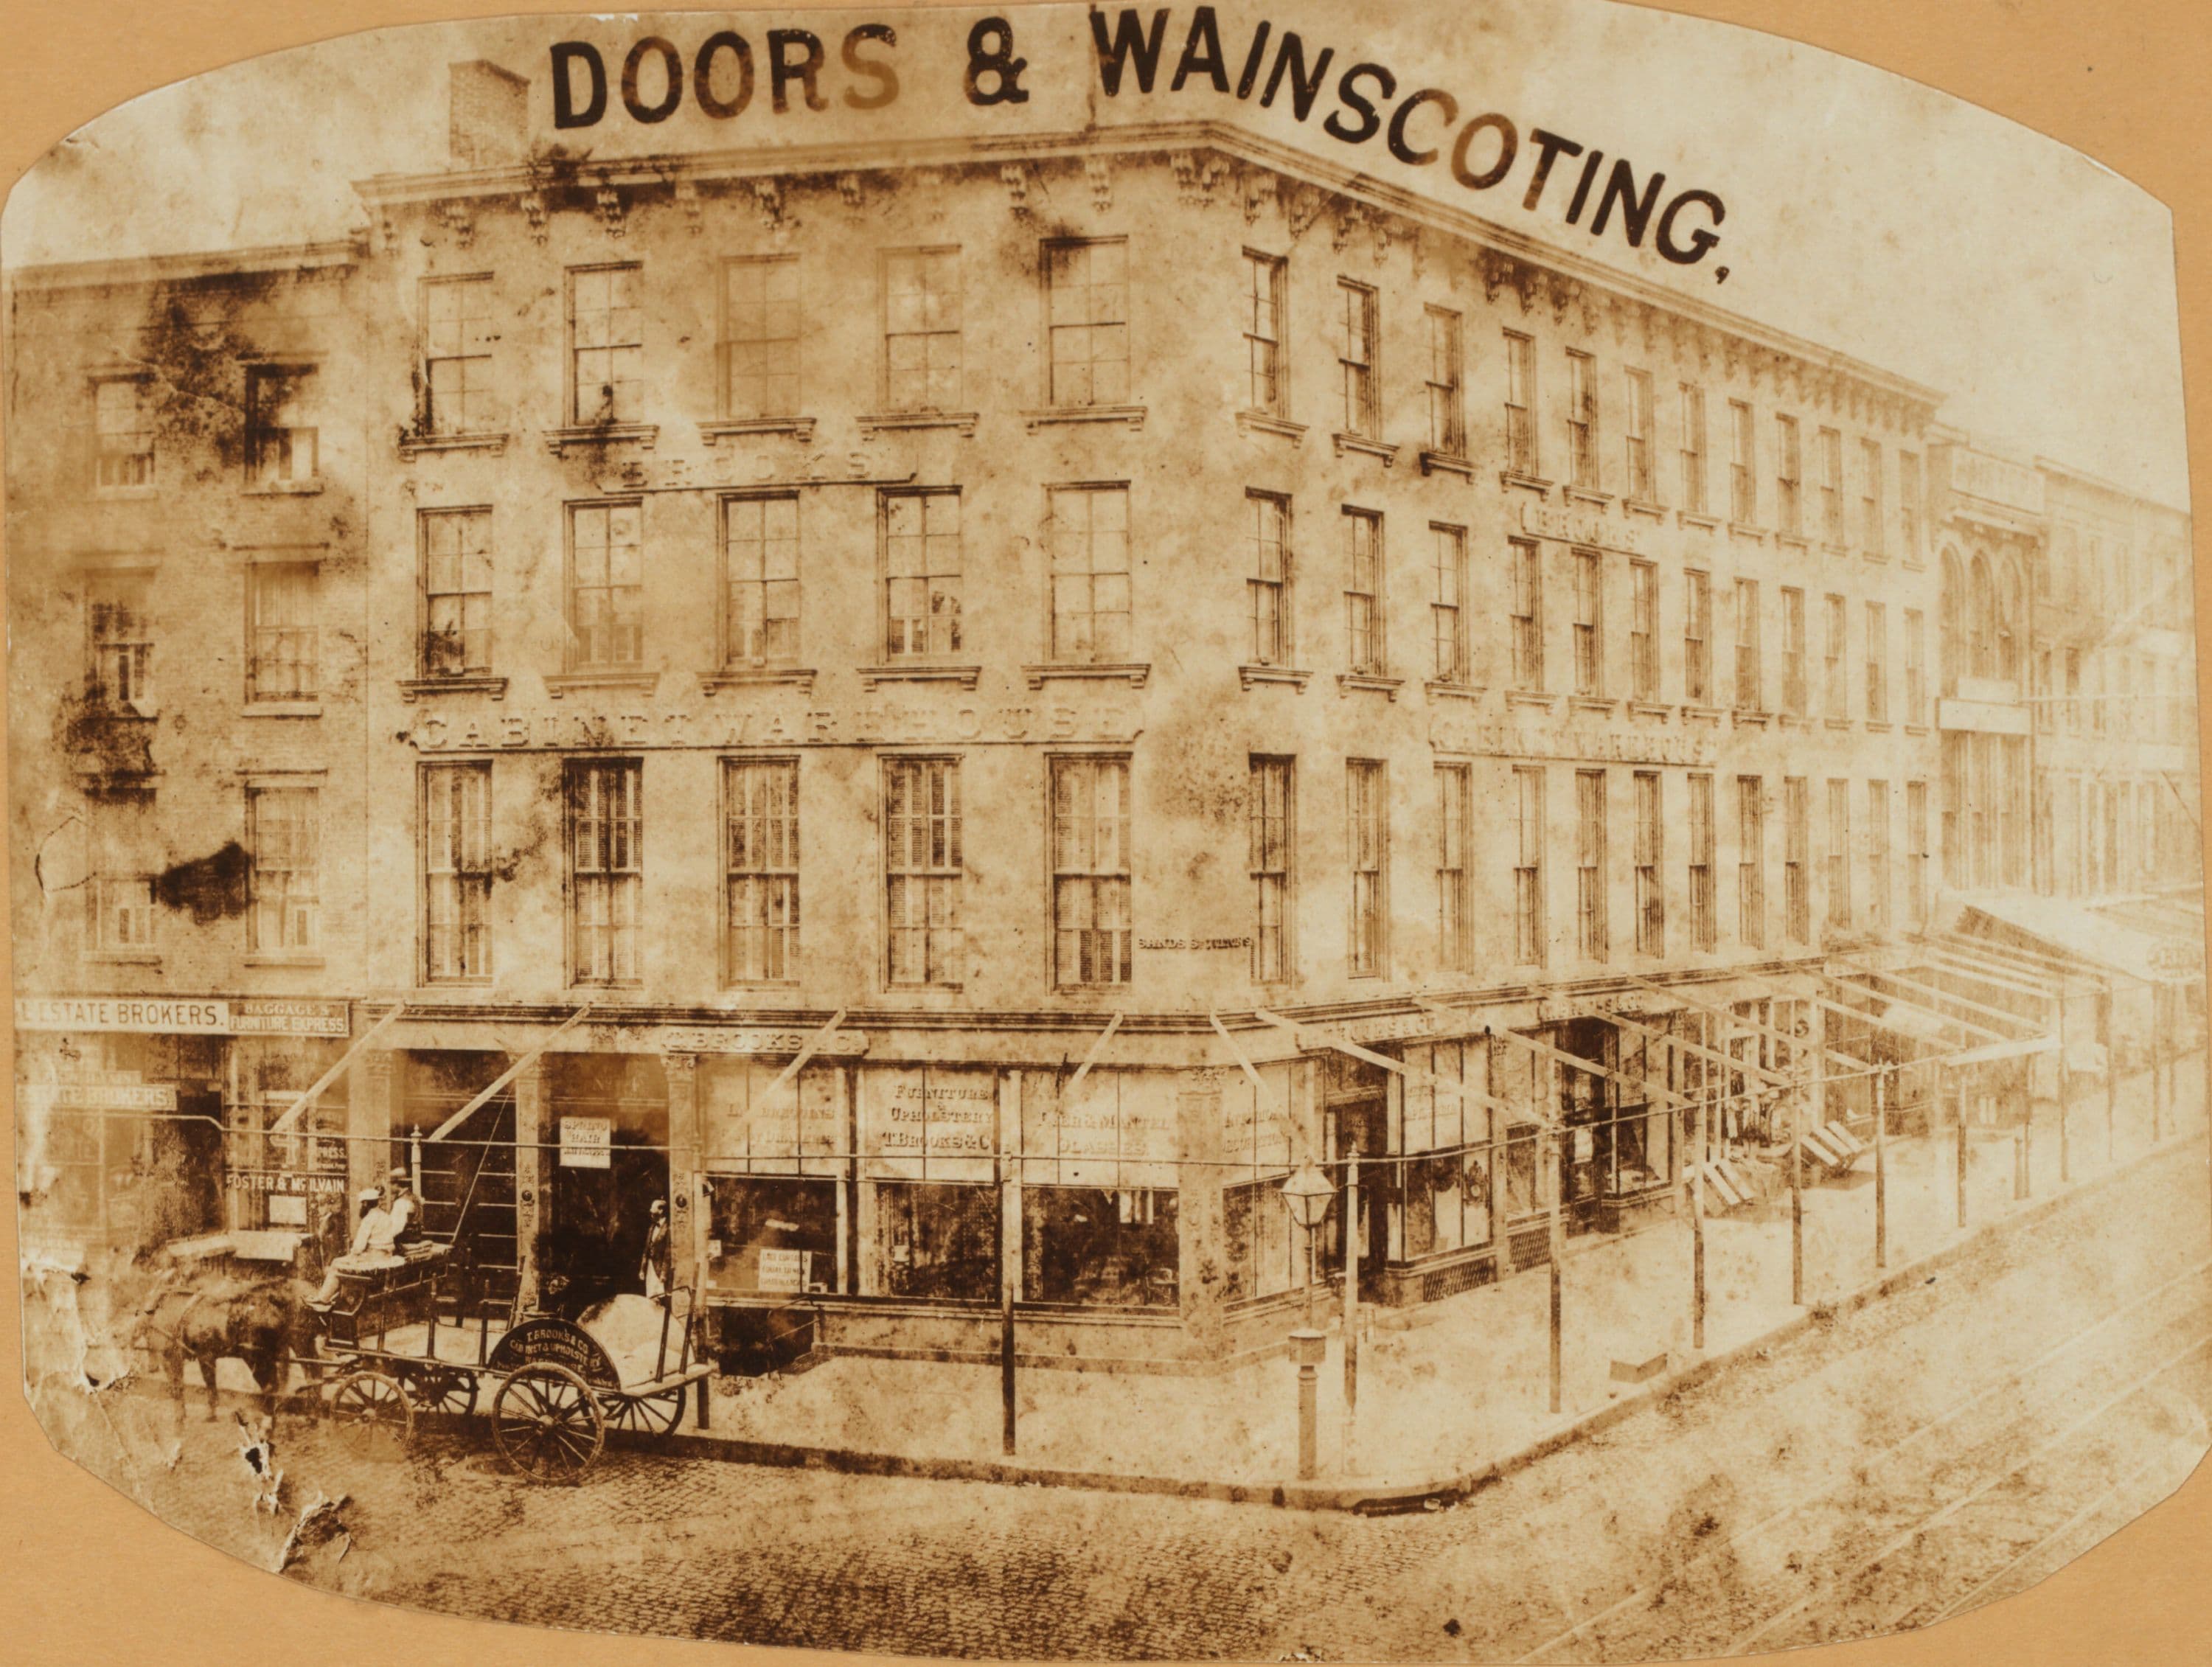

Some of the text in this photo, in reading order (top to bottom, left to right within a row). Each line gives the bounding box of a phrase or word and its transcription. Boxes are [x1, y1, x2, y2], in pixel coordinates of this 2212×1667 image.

[425, 713, 692, 748] CABINET
[39, 1002, 109, 1024] ESTATE
[117, 1003, 224, 1026] BROKERS.
[244, 1003, 316, 1015] BAGGAGE
[229, 1015, 289, 1031] FURNITURE
[692, 1031, 803, 1051] BROOKS
[226, 1175, 274, 1191] FOSTER
[277, 1177, 287, 1191] &
